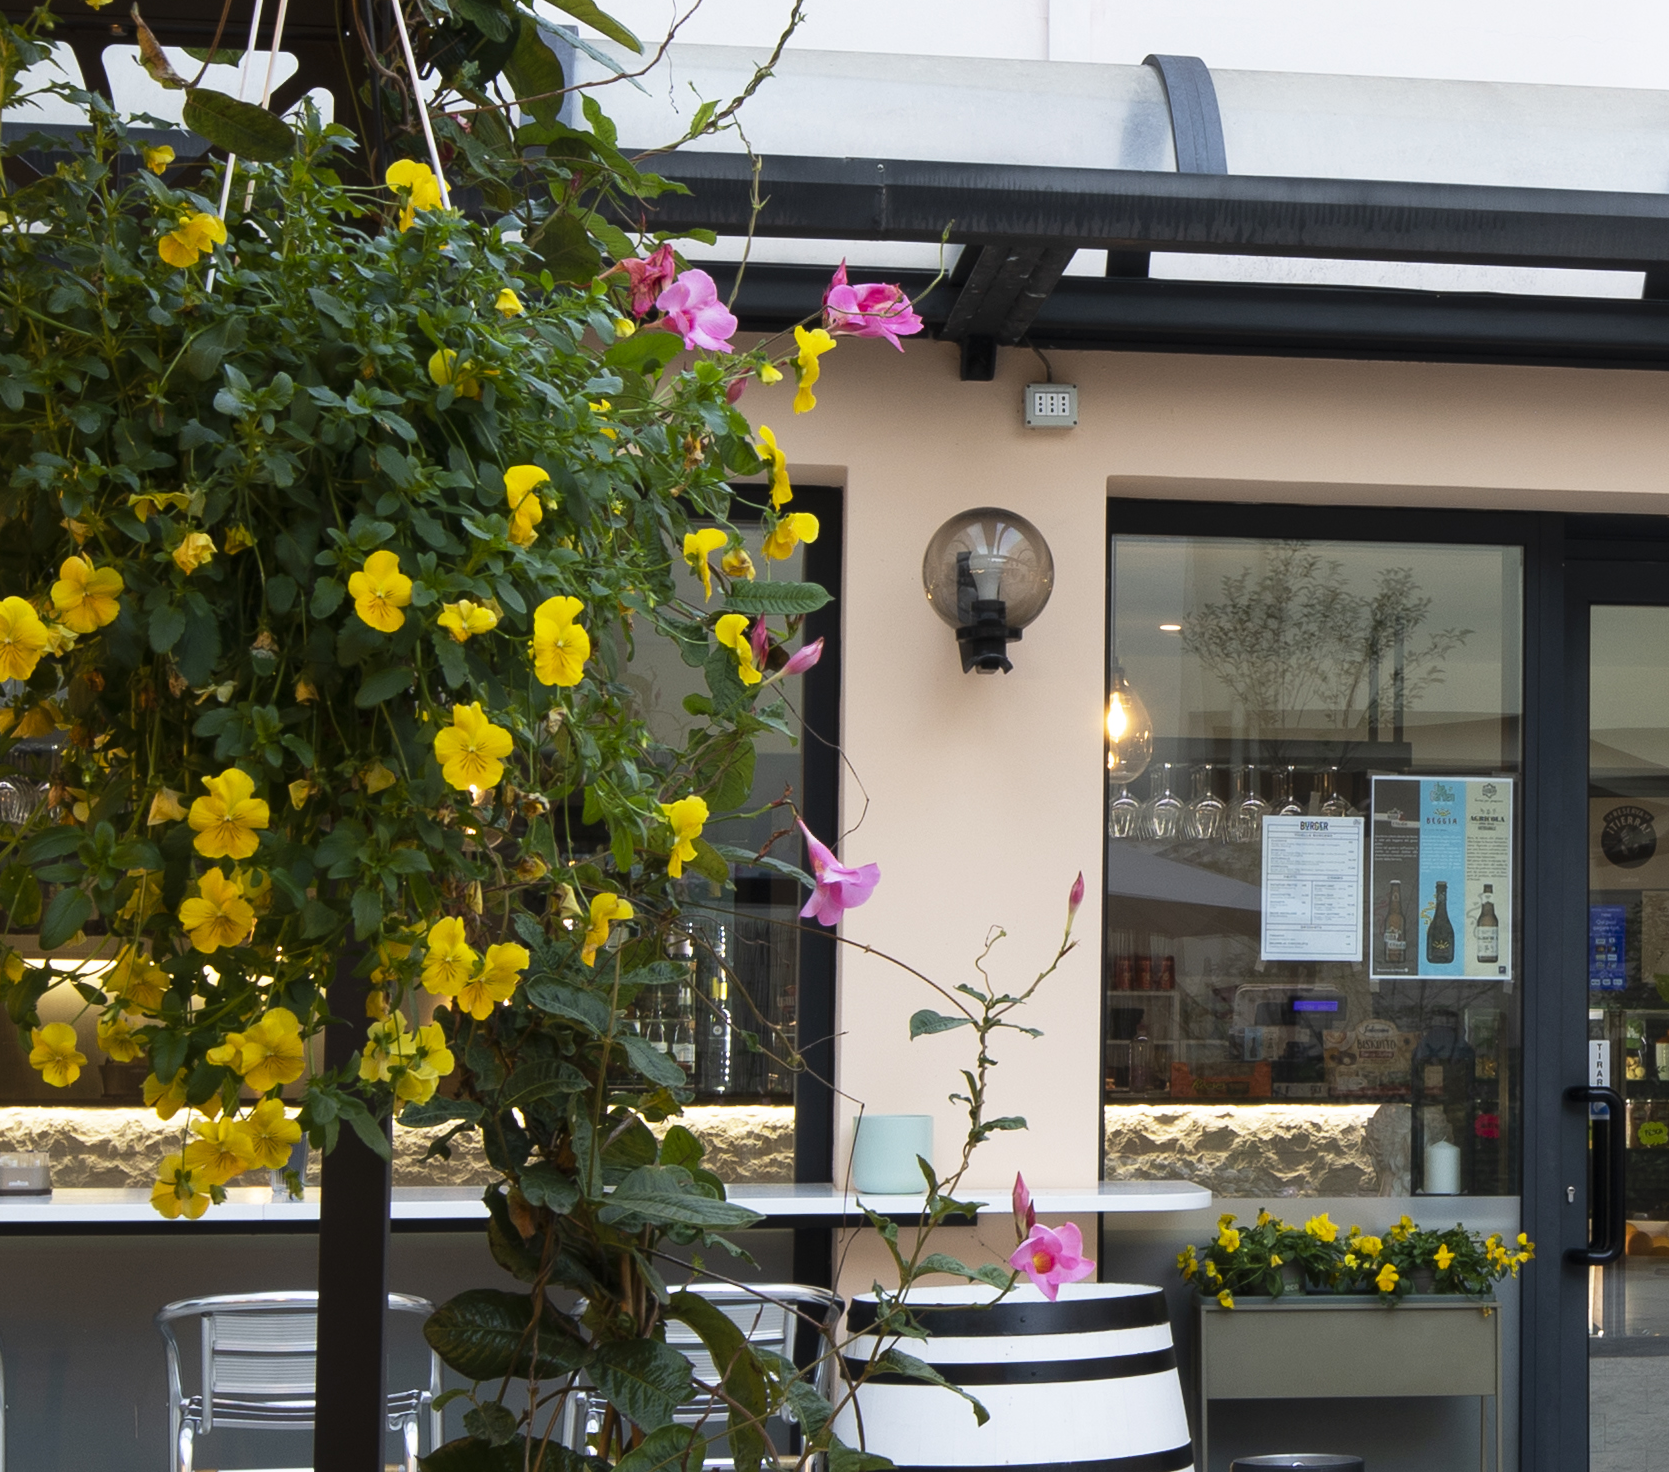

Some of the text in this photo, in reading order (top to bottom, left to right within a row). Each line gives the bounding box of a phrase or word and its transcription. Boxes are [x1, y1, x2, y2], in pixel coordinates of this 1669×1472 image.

[1426, 817, 1457, 825] BEGGIA
[1470, 815, 1506, 823] AGRICOLA
[1300, 821, 1328, 831] BURGER
[1357, 1039, 1396, 1050] BISKOTTO
